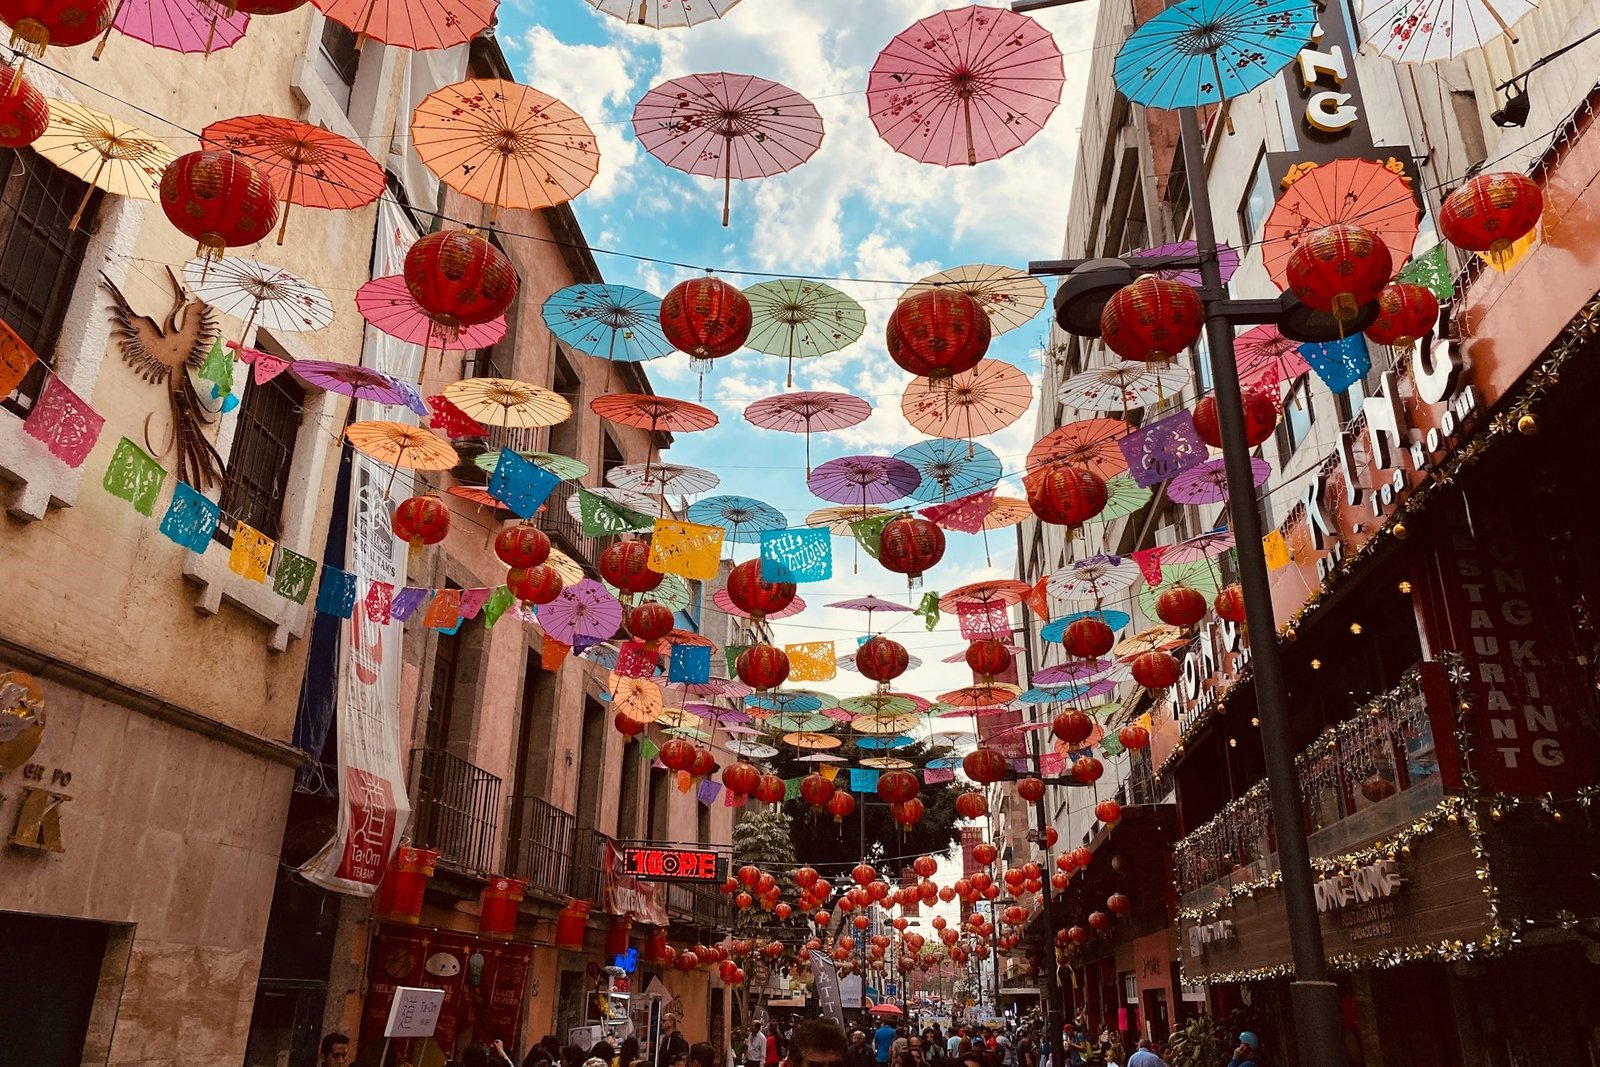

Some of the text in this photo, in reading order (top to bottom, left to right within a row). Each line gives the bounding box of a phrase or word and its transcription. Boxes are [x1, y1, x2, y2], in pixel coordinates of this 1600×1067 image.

[1369, 469, 1406, 517] Tea
[1410, 385, 1476, 471] Room
[1509, 640, 1565, 767] KING
[1342, 902, 1395, 927] RESTAURANT BAR
